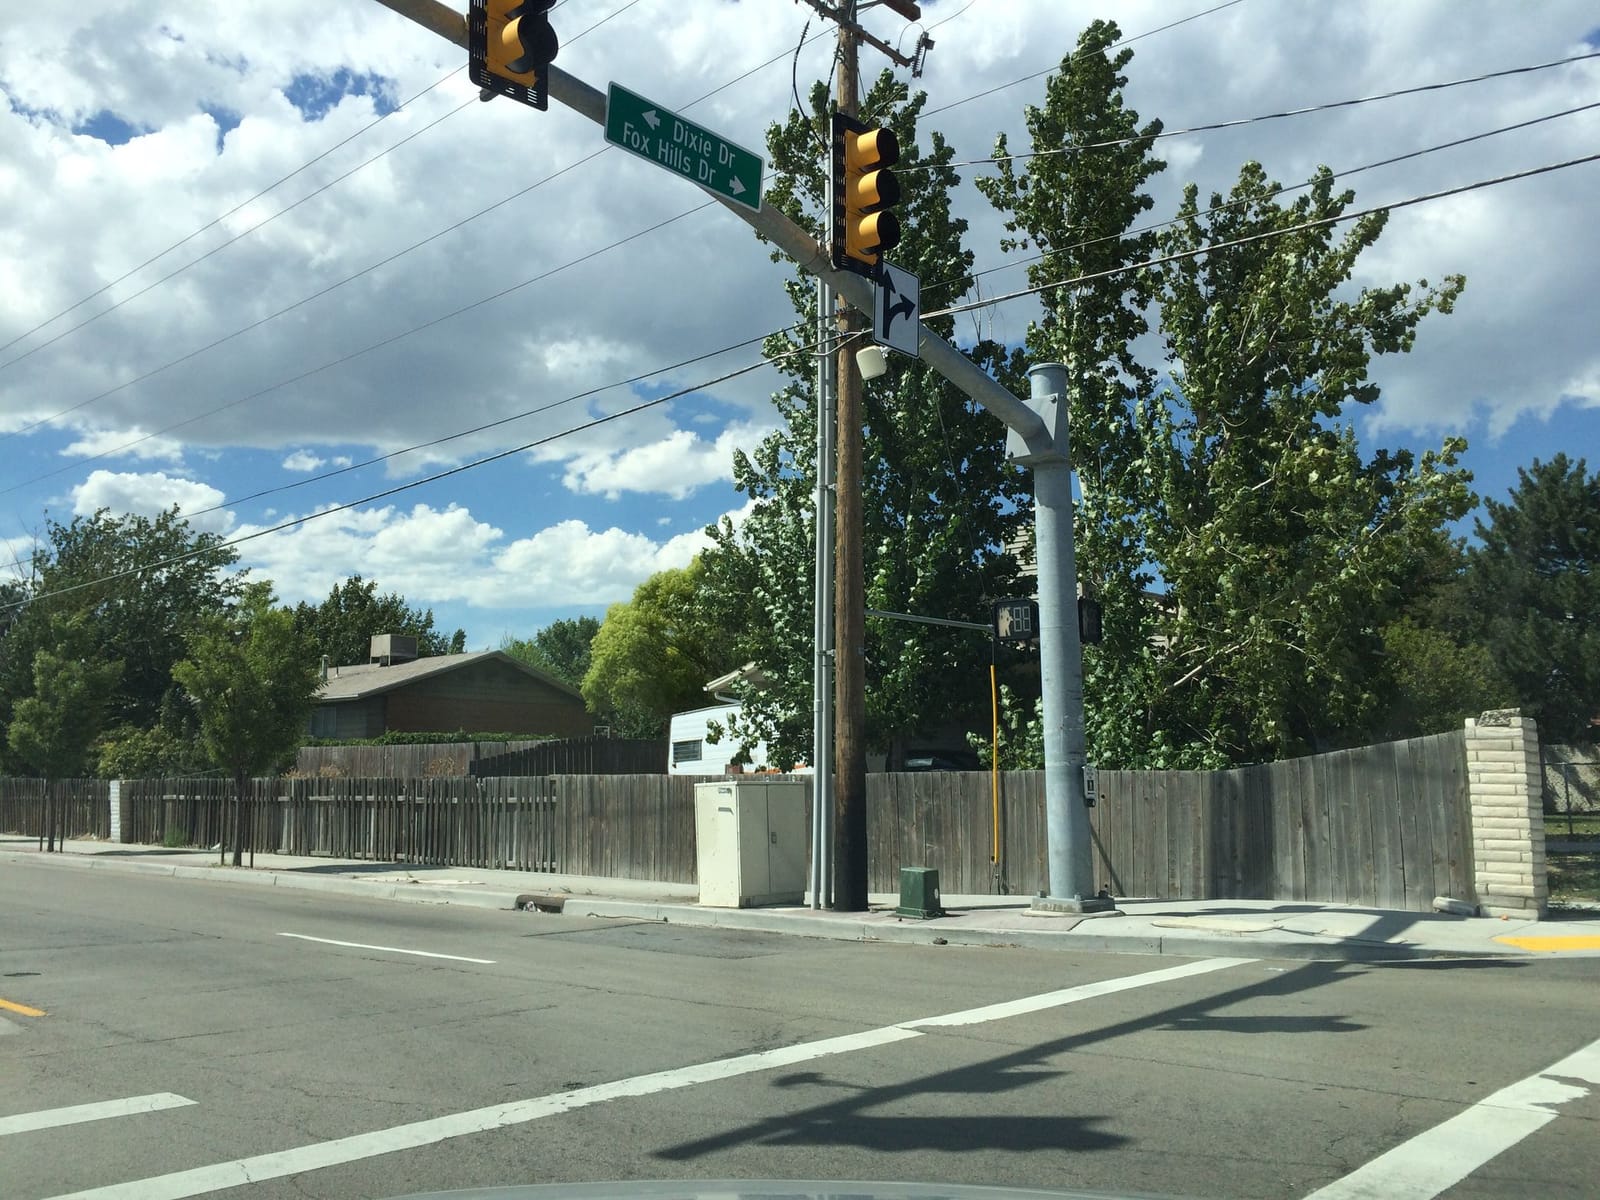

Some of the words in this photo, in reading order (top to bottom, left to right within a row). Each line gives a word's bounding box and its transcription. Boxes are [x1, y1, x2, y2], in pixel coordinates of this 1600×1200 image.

[622, 121, 650, 154] Fox
[657, 138, 691, 174] Hills
[698, 158, 717, 184] Dr
[673, 120, 712, 157] Dixie
[718, 142, 736, 169] Dr
